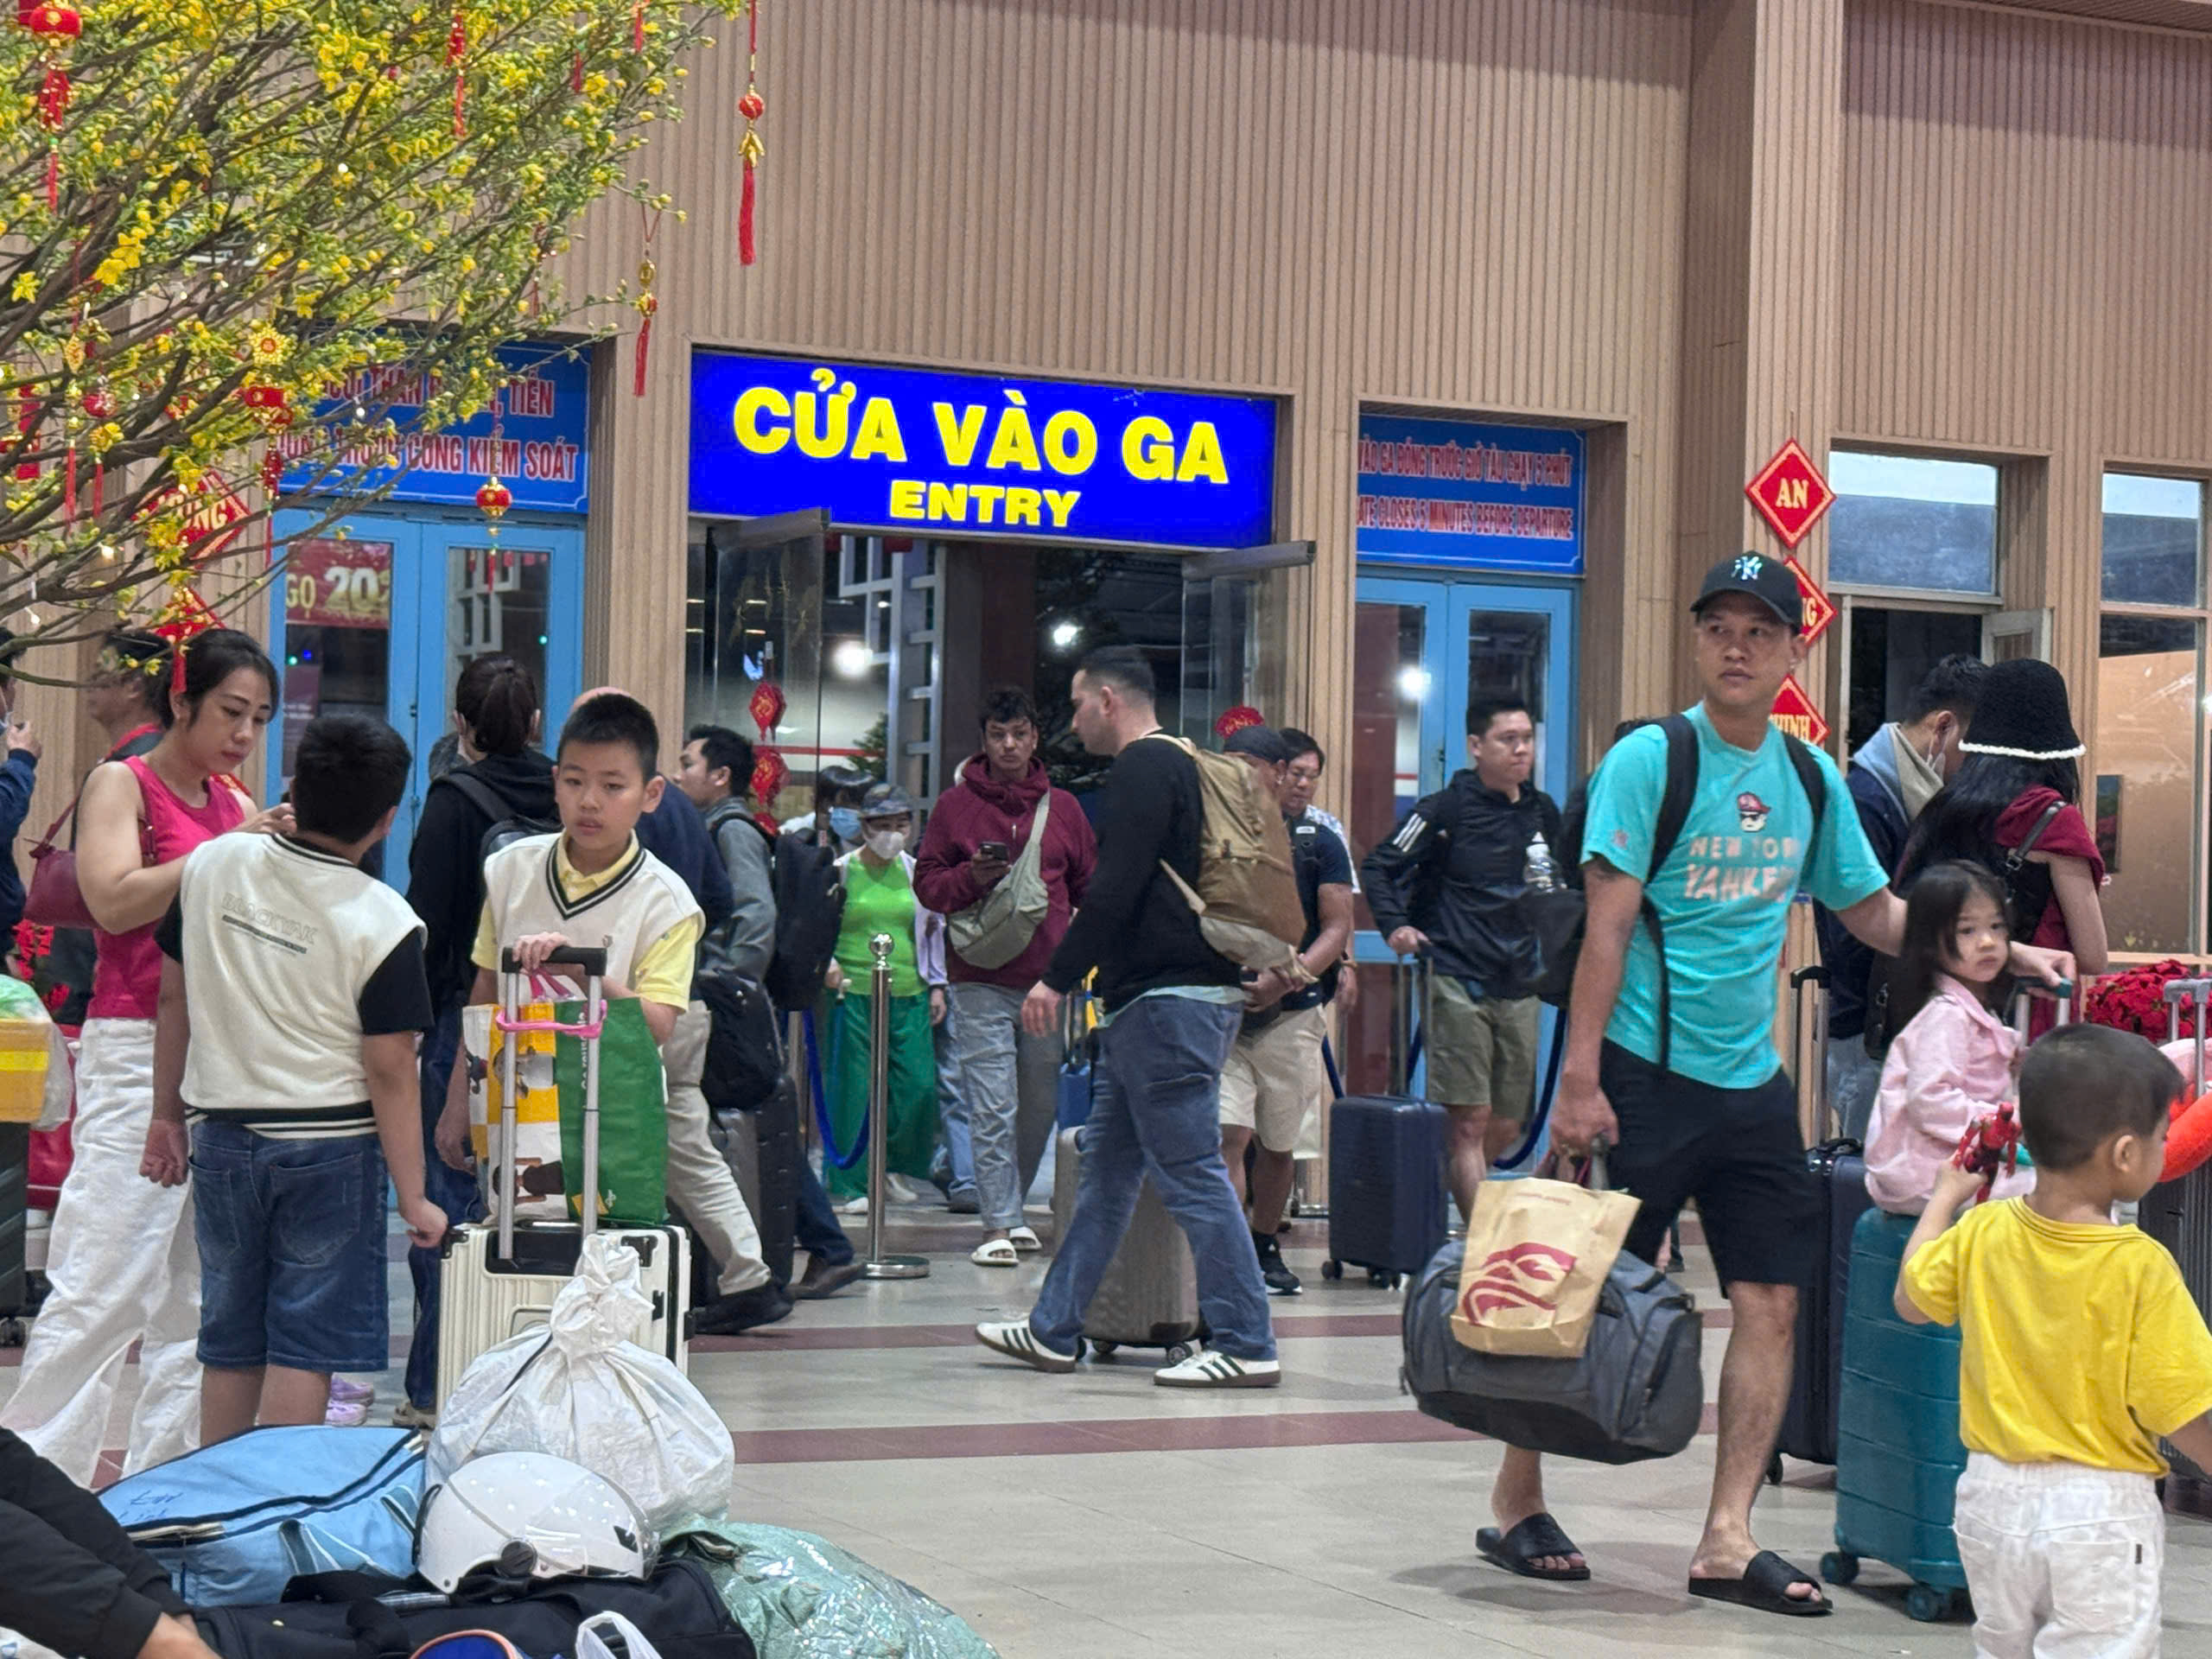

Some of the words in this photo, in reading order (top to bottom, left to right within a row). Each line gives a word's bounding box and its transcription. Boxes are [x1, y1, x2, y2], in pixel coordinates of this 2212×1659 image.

[734, 367, 907, 462] CỬA
[932, 389, 1097, 475] VÀO
[1122, 416, 1229, 484] GA
[467, 423, 521, 478] KIỂM
[524, 435, 579, 483] SOÁT
[1380, 442, 1395, 475] GA
[1484, 442, 1505, 484] TÀU
[1506, 450, 1535, 492] CHẠY
[1535, 454, 1542, 486] 5
[1543, 448, 1573, 487] PHÚT
[890, 479, 1081, 527] ENTRY
[1356, 494, 1376, 528] ATE
[1378, 496, 1417, 531] CLOSES
[1419, 499, 1427, 532] 5
[1427, 499, 1472, 535] MINUTES
[1474, 502, 1514, 537] BEFORE
[1515, 504, 1573, 540] DEPARTURE
[1775, 477, 1809, 510] AN
[285, 572, 316, 620] GỌ
